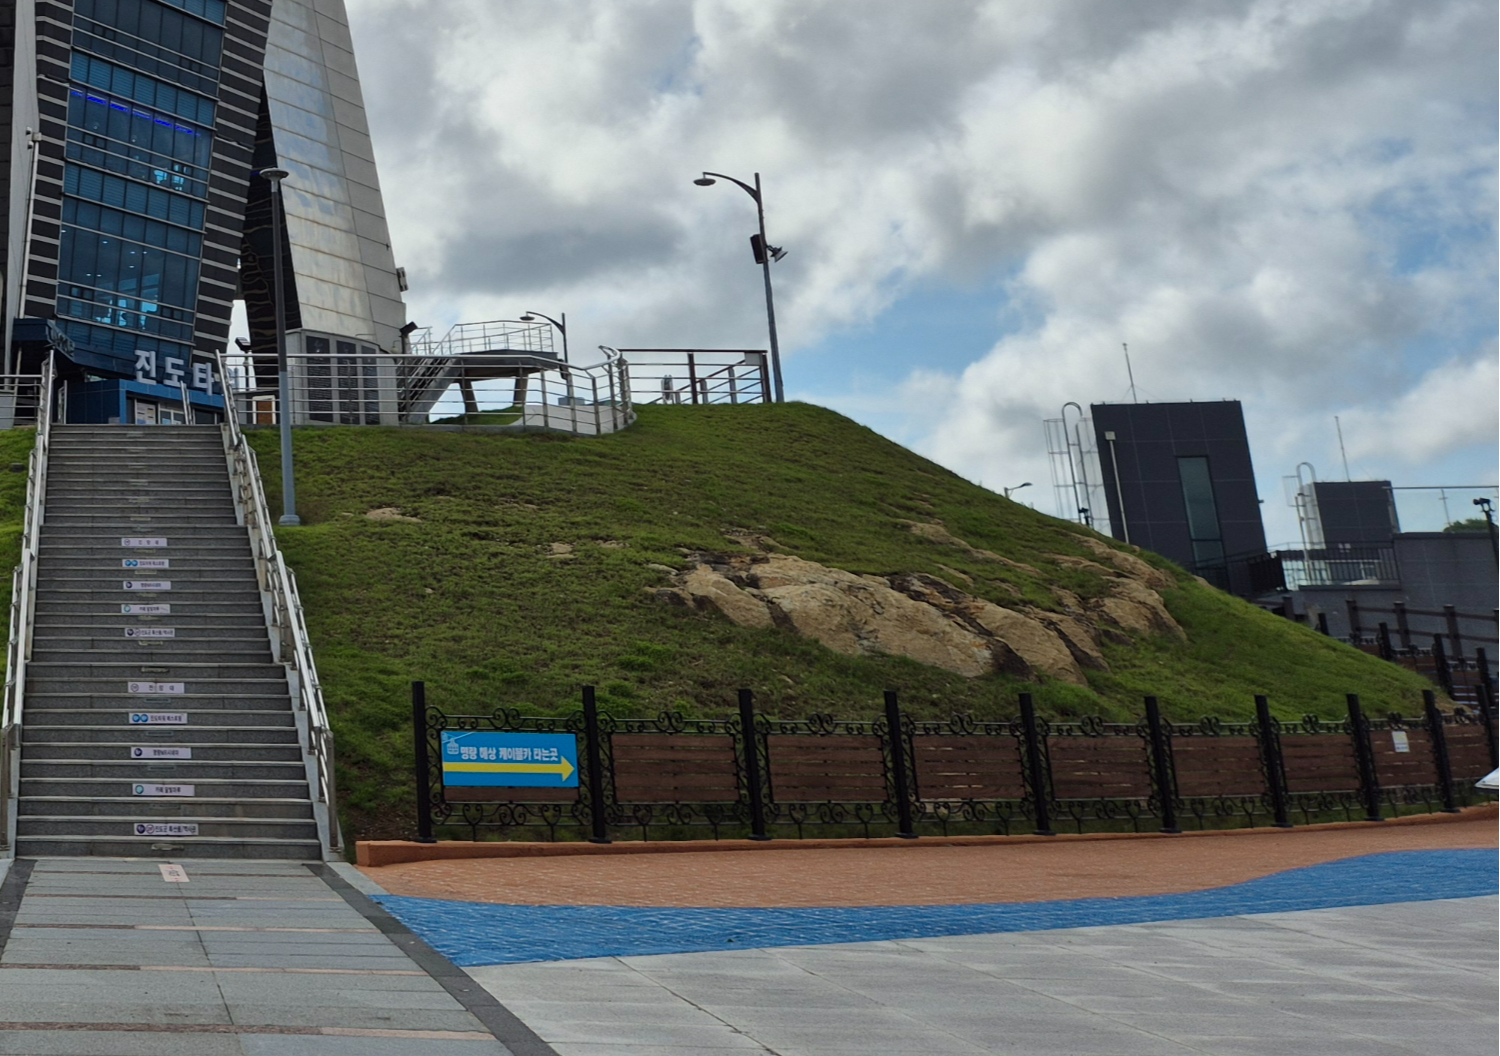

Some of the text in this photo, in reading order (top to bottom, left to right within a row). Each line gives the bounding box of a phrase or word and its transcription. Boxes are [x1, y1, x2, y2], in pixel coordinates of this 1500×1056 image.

[460, 746, 559, 761] 명량 해상 케이블카 타는곳
